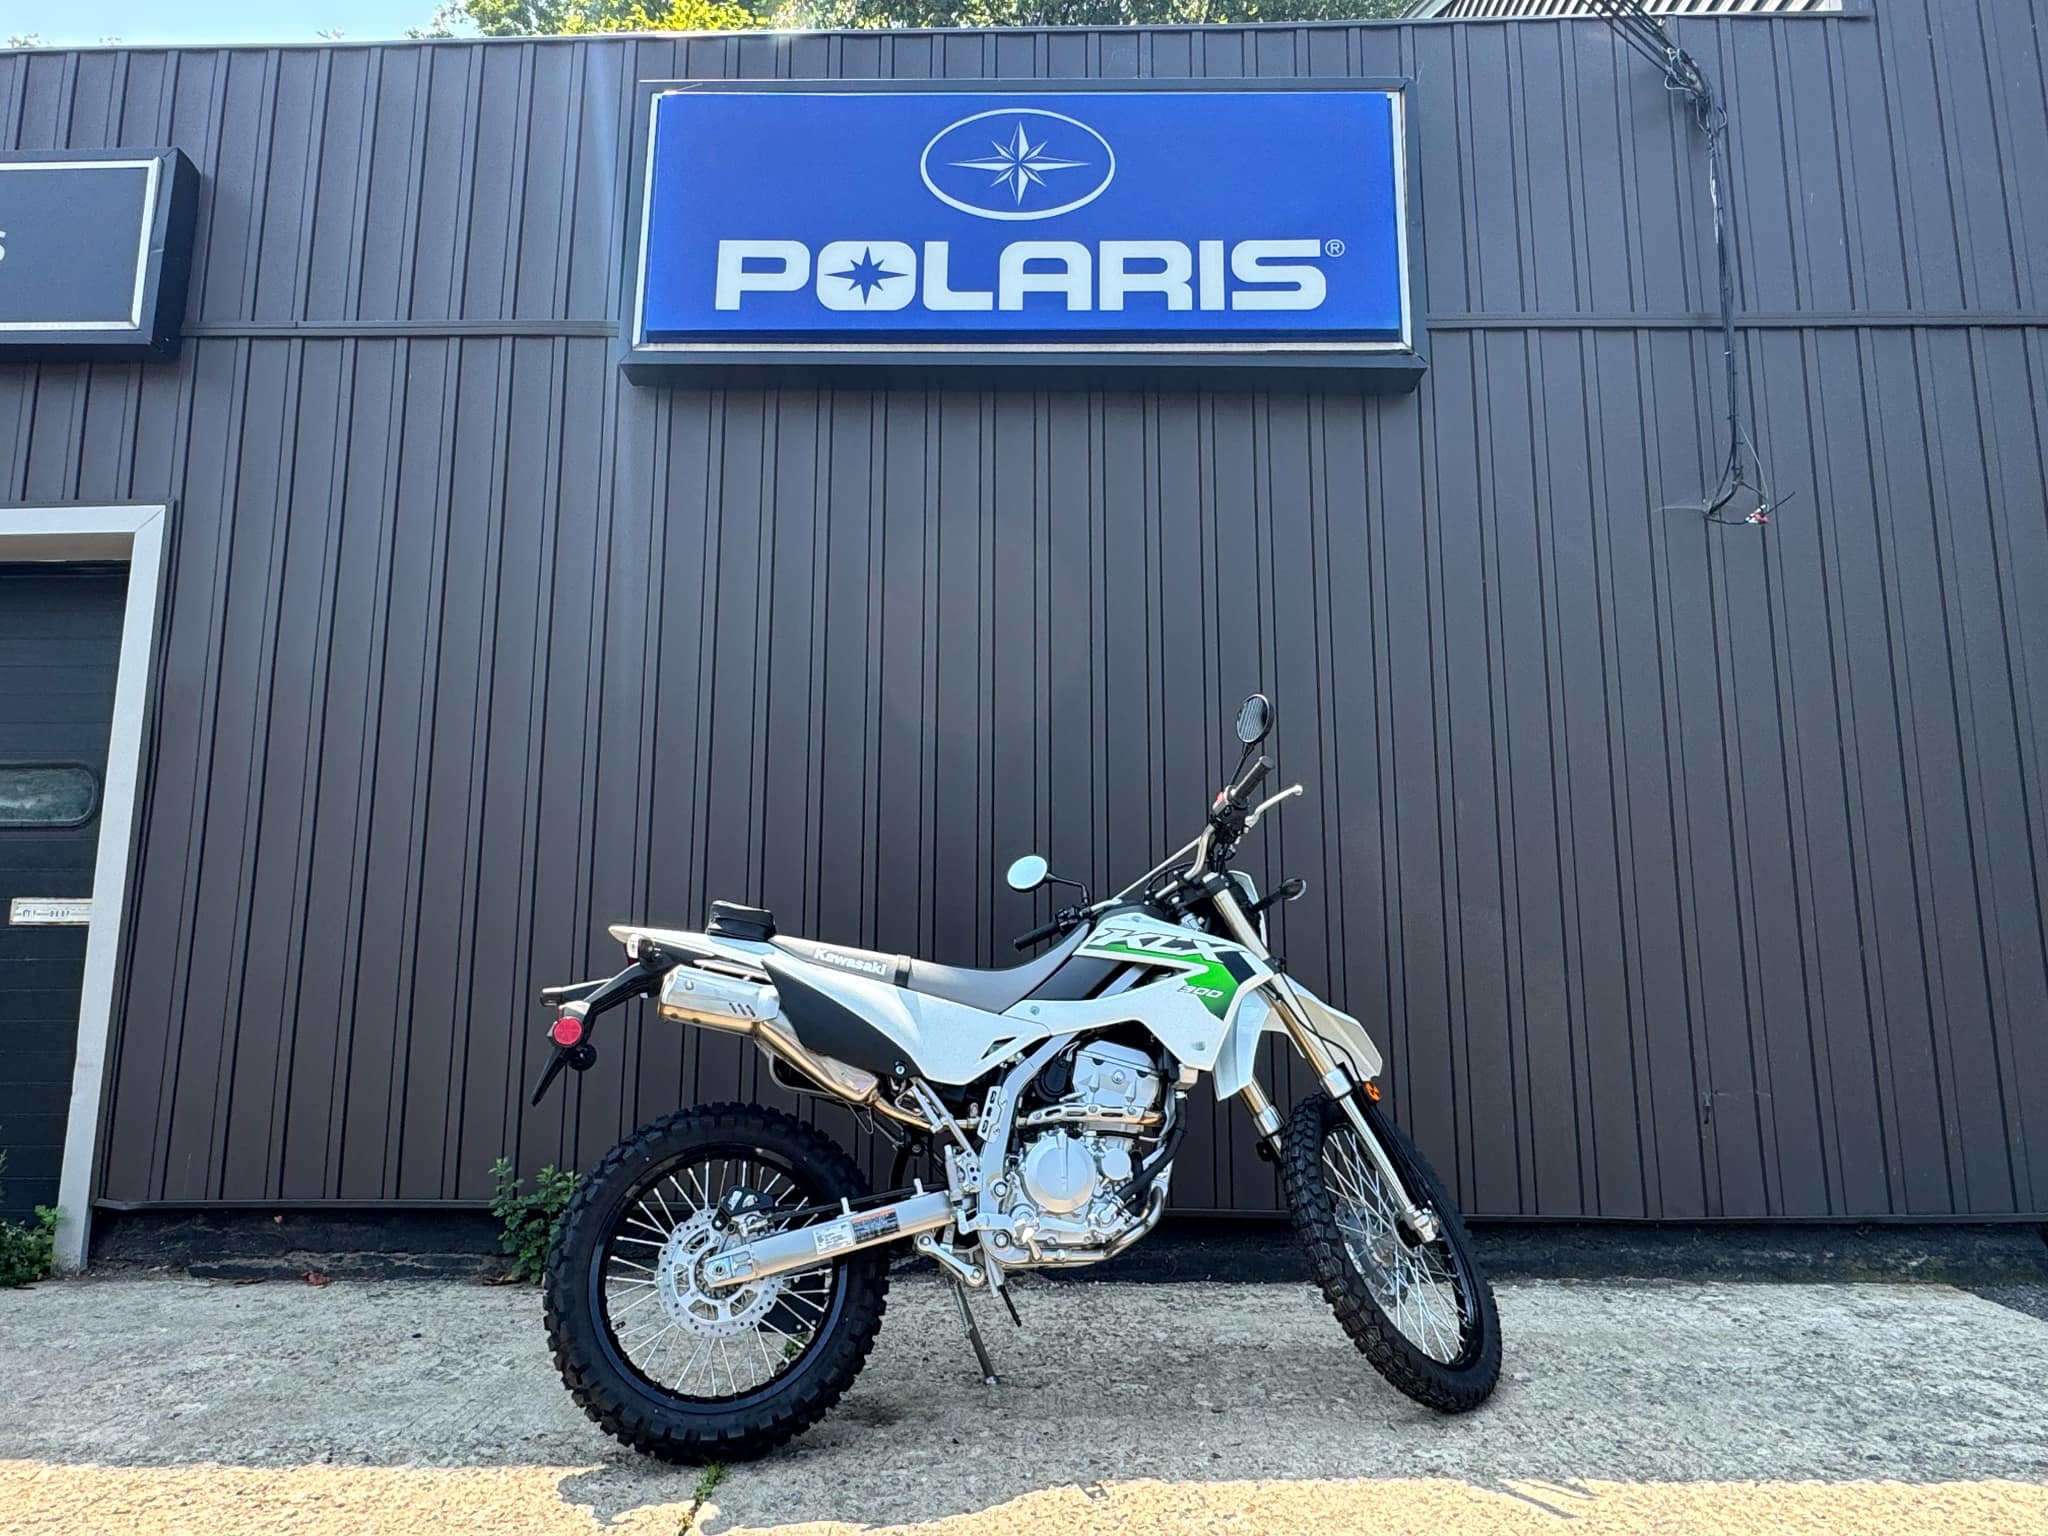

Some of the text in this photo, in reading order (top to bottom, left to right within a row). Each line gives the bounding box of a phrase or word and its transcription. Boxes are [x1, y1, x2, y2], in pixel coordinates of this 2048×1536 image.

[1089, 928, 1245, 964] KLX
[813, 947, 887, 976] Kawasaki
[1177, 985, 1224, 998] 300
